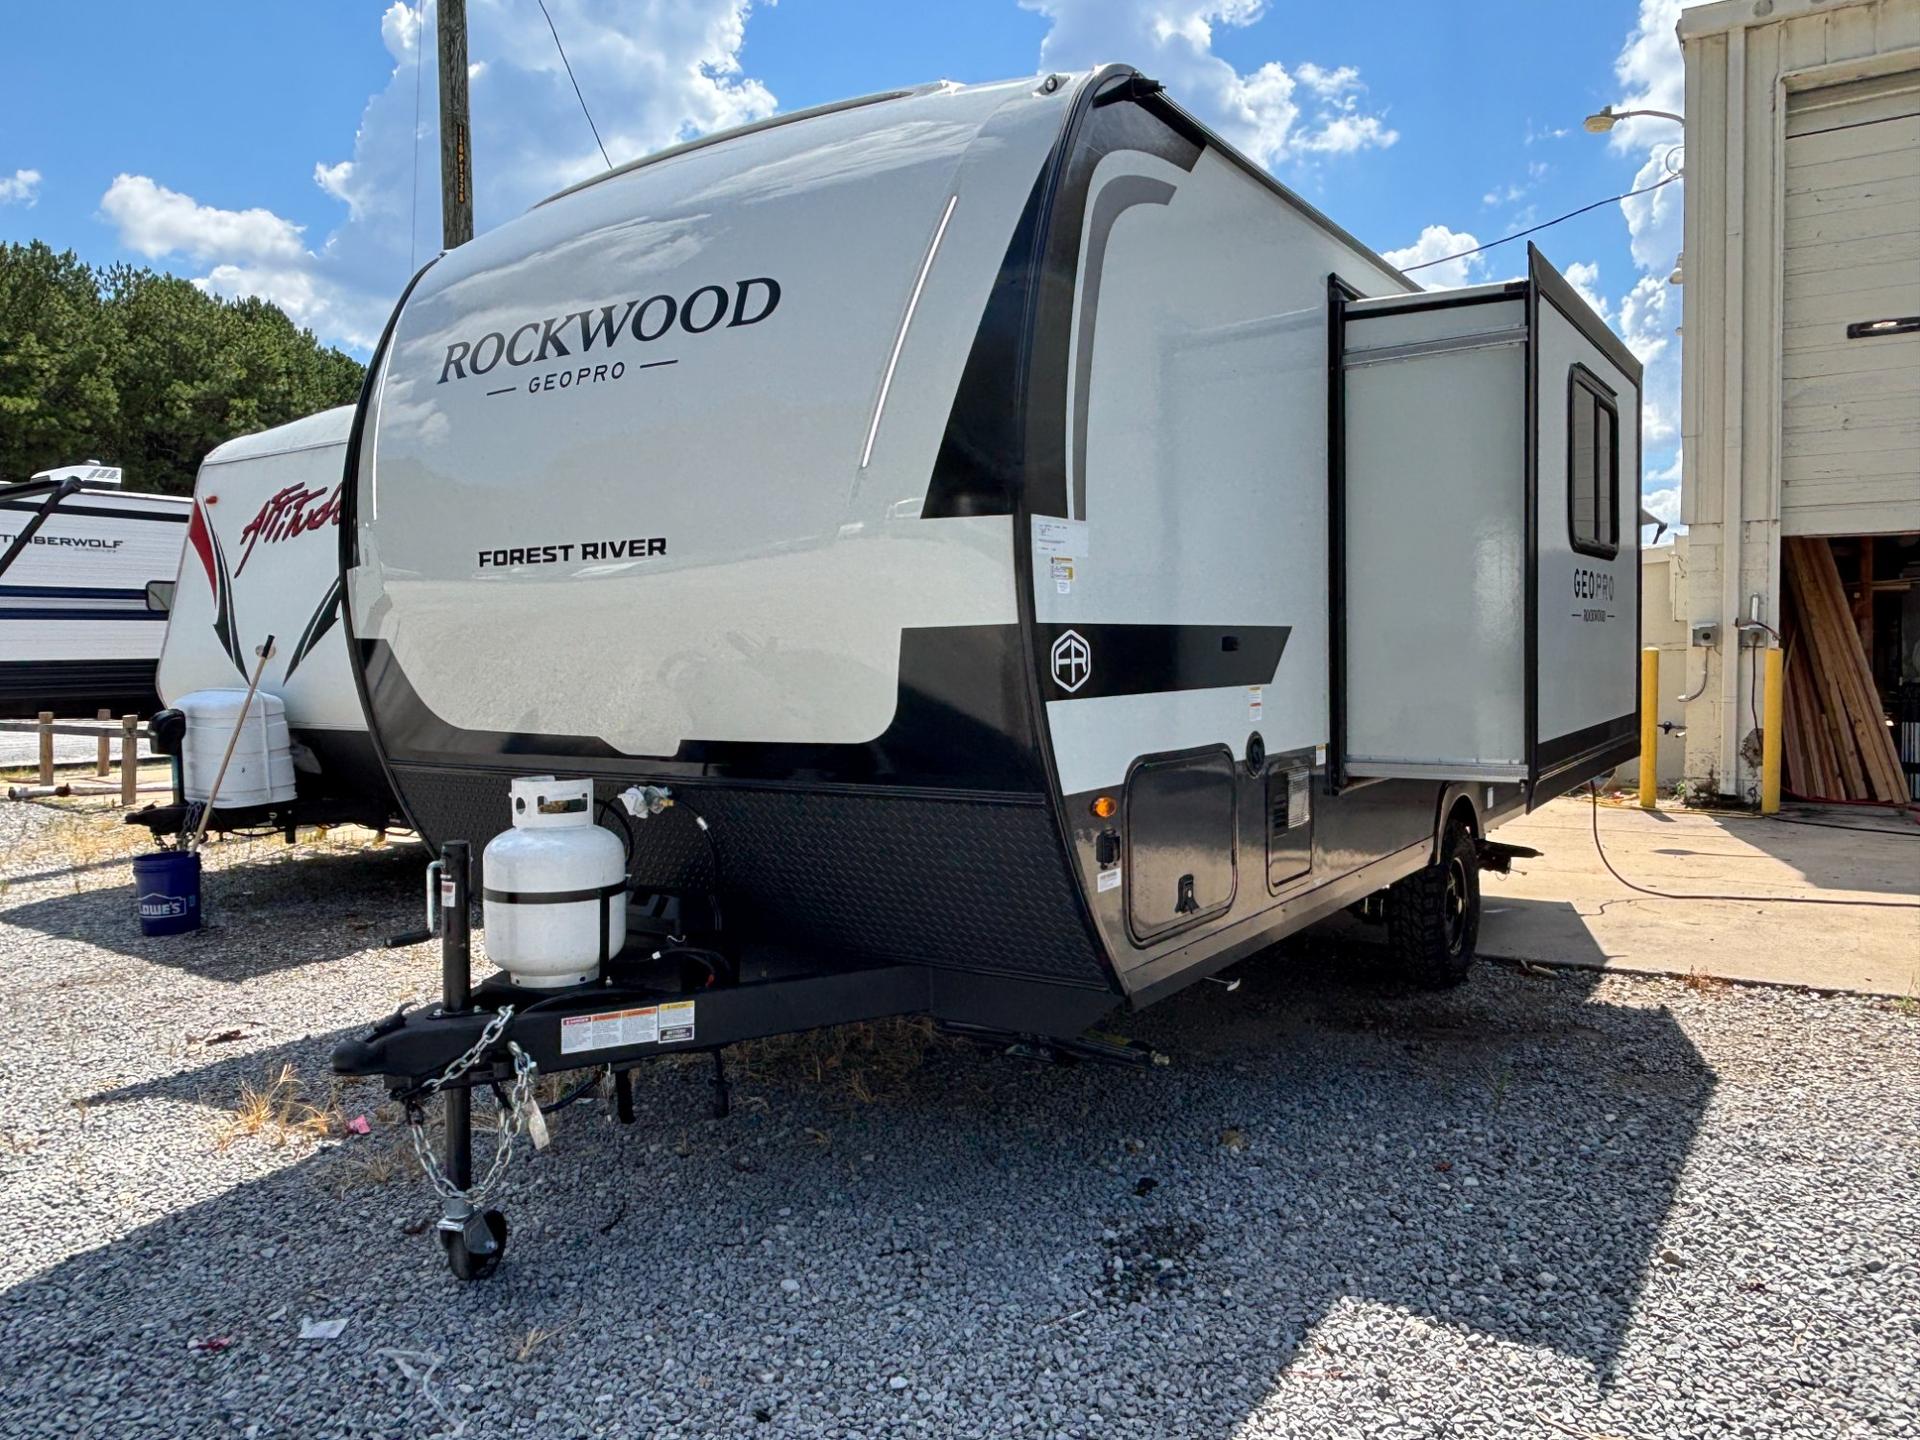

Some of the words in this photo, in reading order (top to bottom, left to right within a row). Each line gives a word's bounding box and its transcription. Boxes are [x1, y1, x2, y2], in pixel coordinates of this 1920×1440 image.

[437, 277, 781, 385] ROCKWOOD
[528, 361, 626, 394] GEOPRO
[0, 534, 124, 549] TIBERWOLF
[478, 544, 574, 568] FOREST
[581, 538, 667, 561] RIVER
[1573, 568, 1615, 602] GEOPRO
[138, 902, 181, 916] LOWE'S
